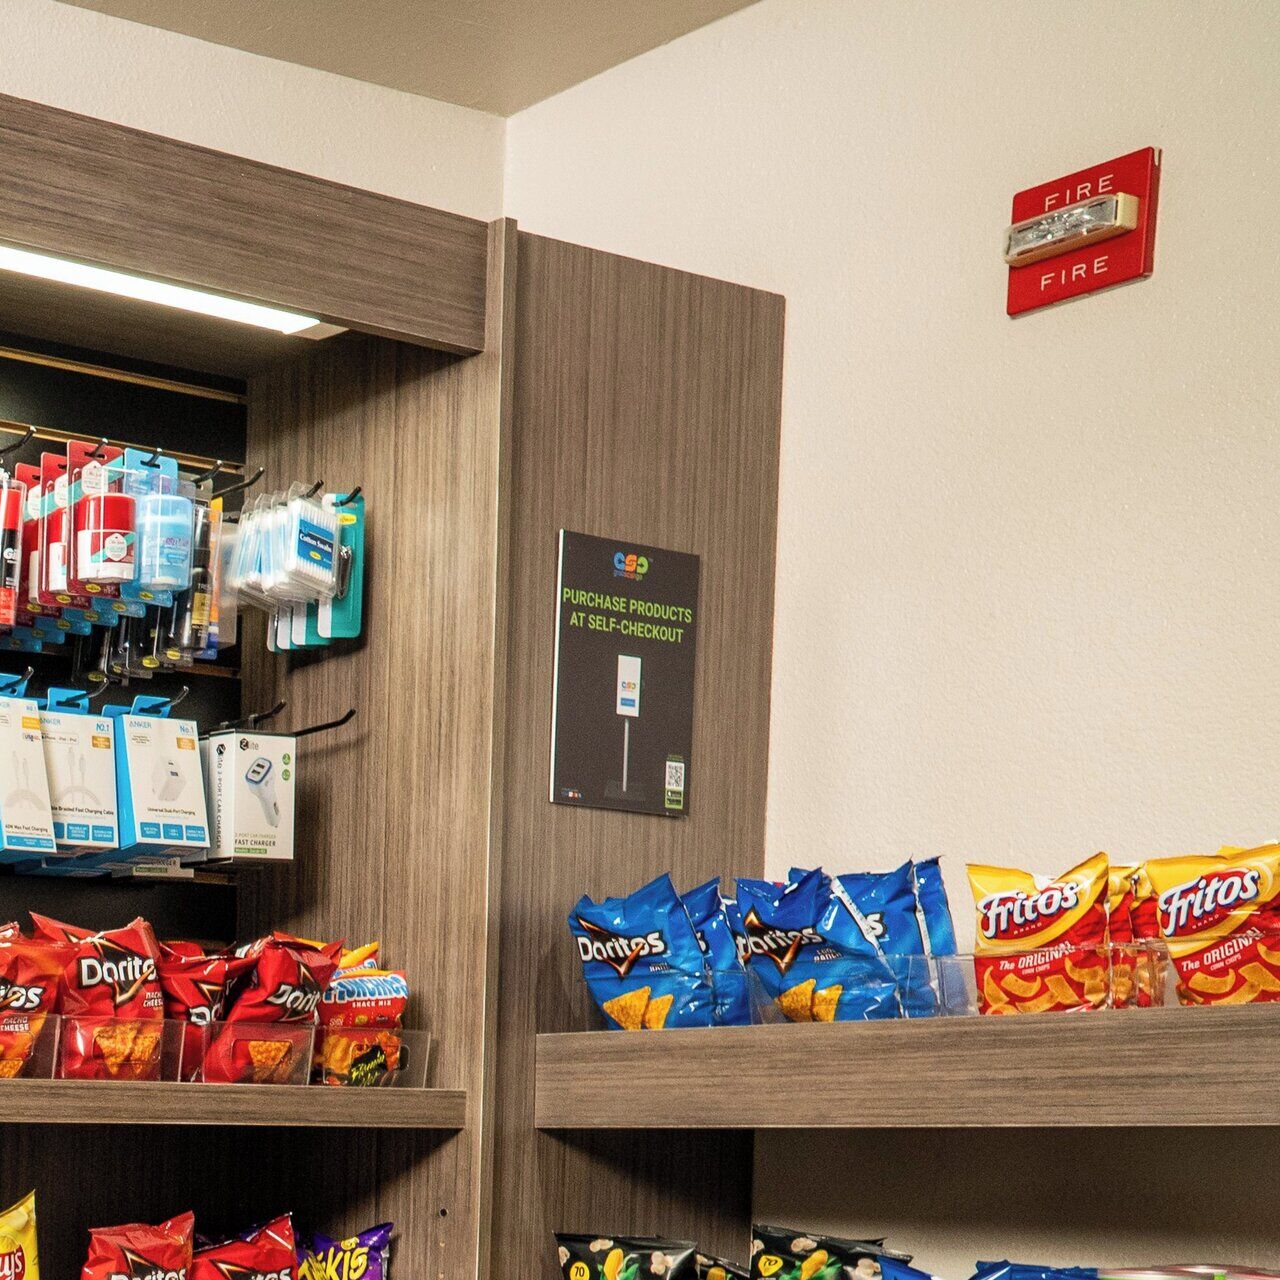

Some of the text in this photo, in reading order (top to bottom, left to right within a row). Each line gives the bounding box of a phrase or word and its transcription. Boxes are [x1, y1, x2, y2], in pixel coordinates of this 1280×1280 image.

[1045, 175, 1114, 211] FIRE
[1041, 256, 1108, 291] FIRE
[563, 587, 692, 623] PURCHASE PRODUCTS
[570, 612, 683, 642] AT SELF-CHECKOUT
[977, 882, 1079, 938] Fritos
[1158, 869, 1261, 936] Fritos
[577, 932, 665, 962] Doritos
[999, 942, 1076, 970] The ORIGINAL
[1182, 930, 1261, 971] The ORIGINAL
